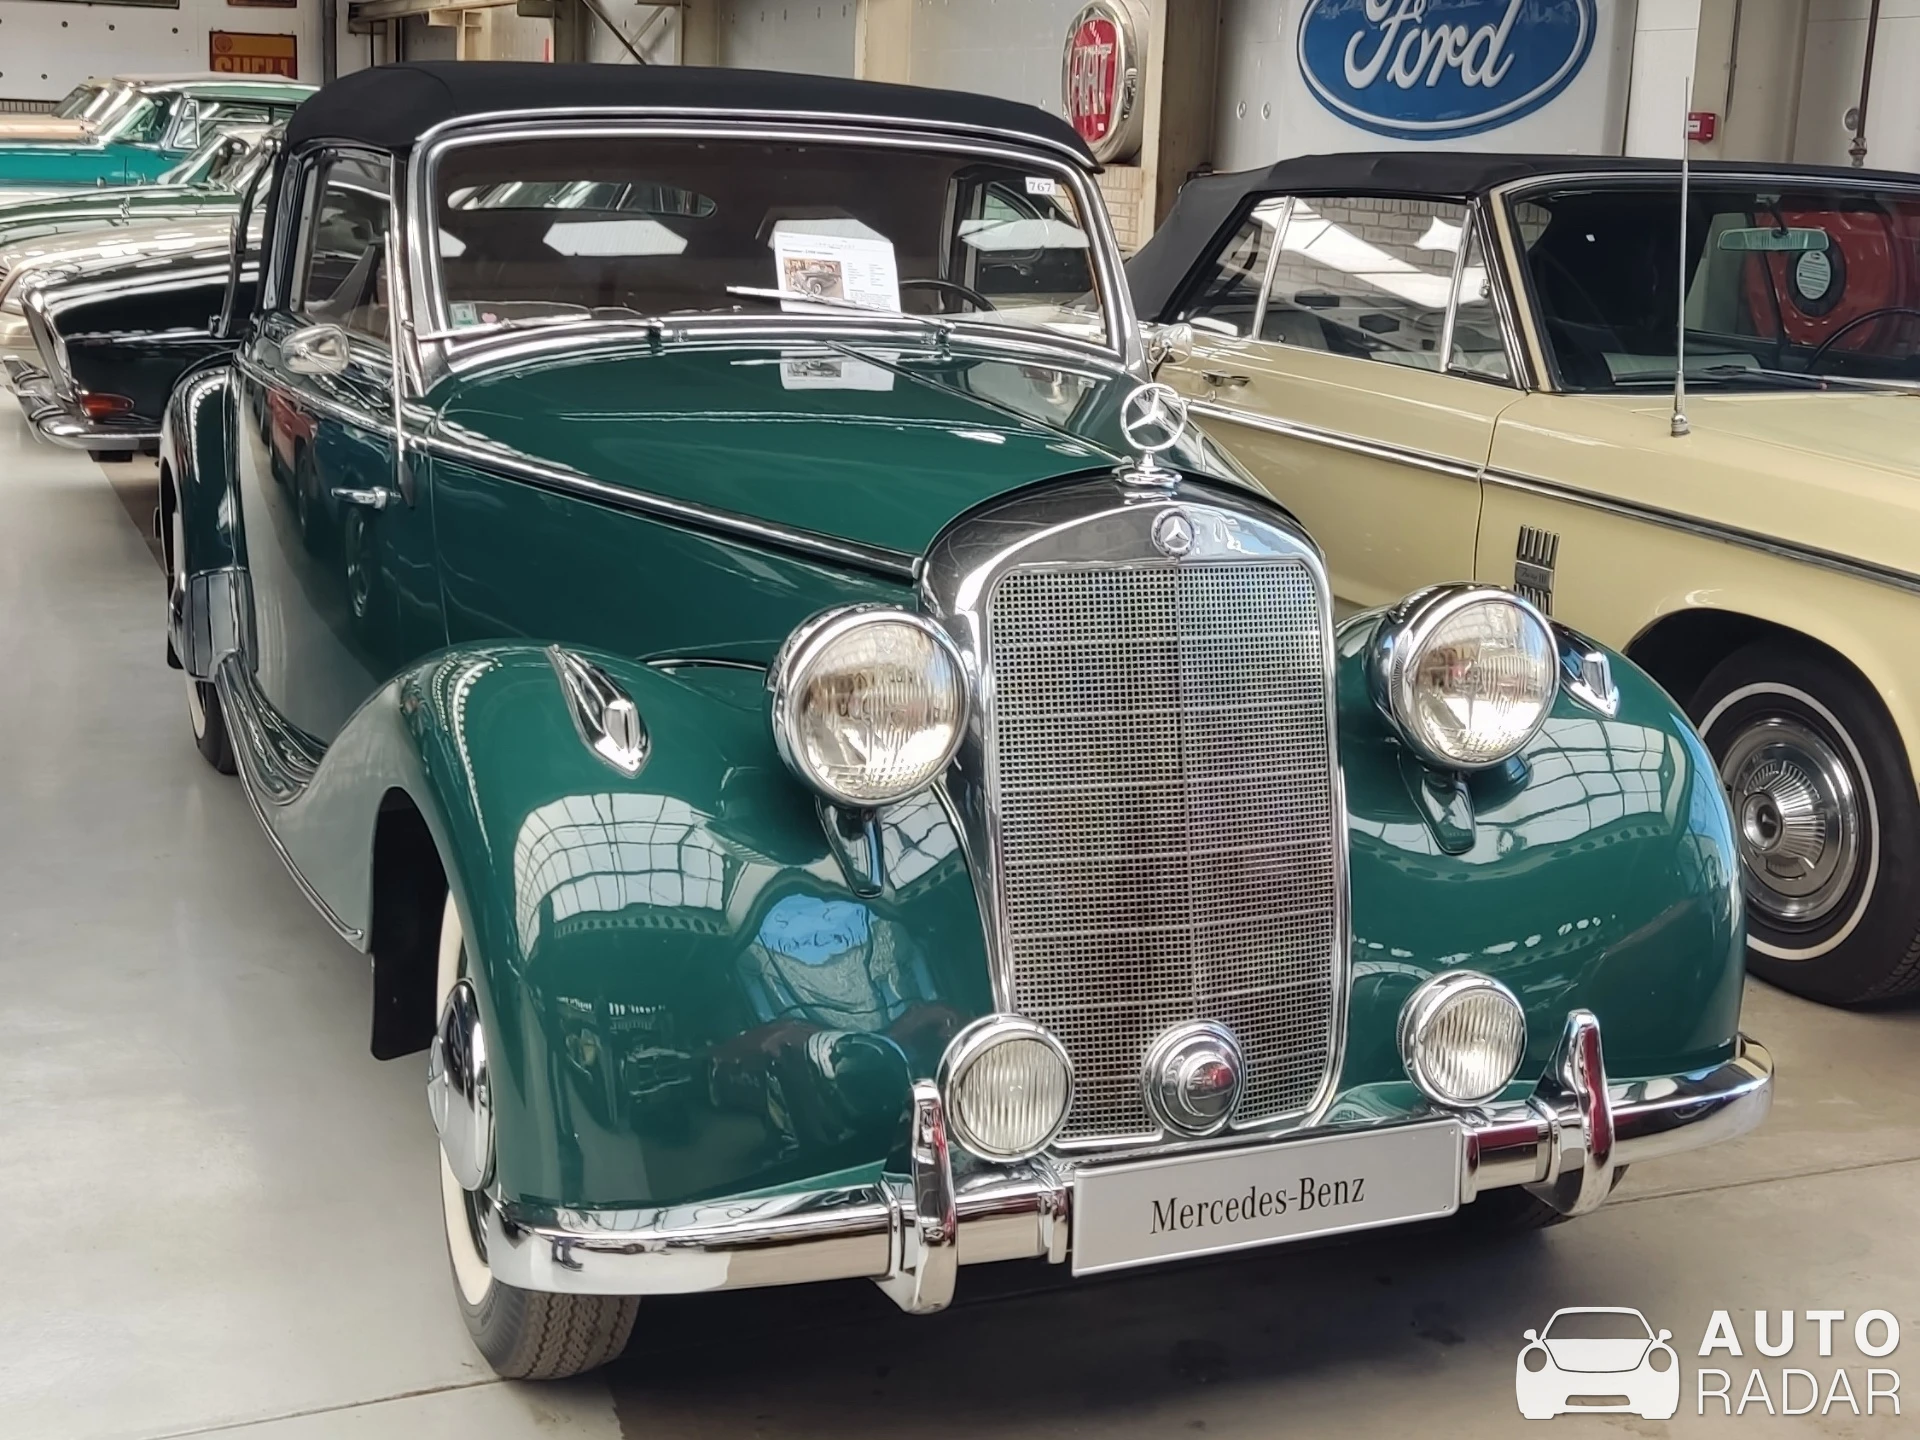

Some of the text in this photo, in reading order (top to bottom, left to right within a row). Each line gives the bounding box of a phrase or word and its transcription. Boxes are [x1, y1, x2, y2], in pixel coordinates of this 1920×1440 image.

[1344, 0, 1515, 89] Ford
[1029, 181, 1051, 192] 767
[1150, 1177, 1365, 1234] Mercedes-Benz
